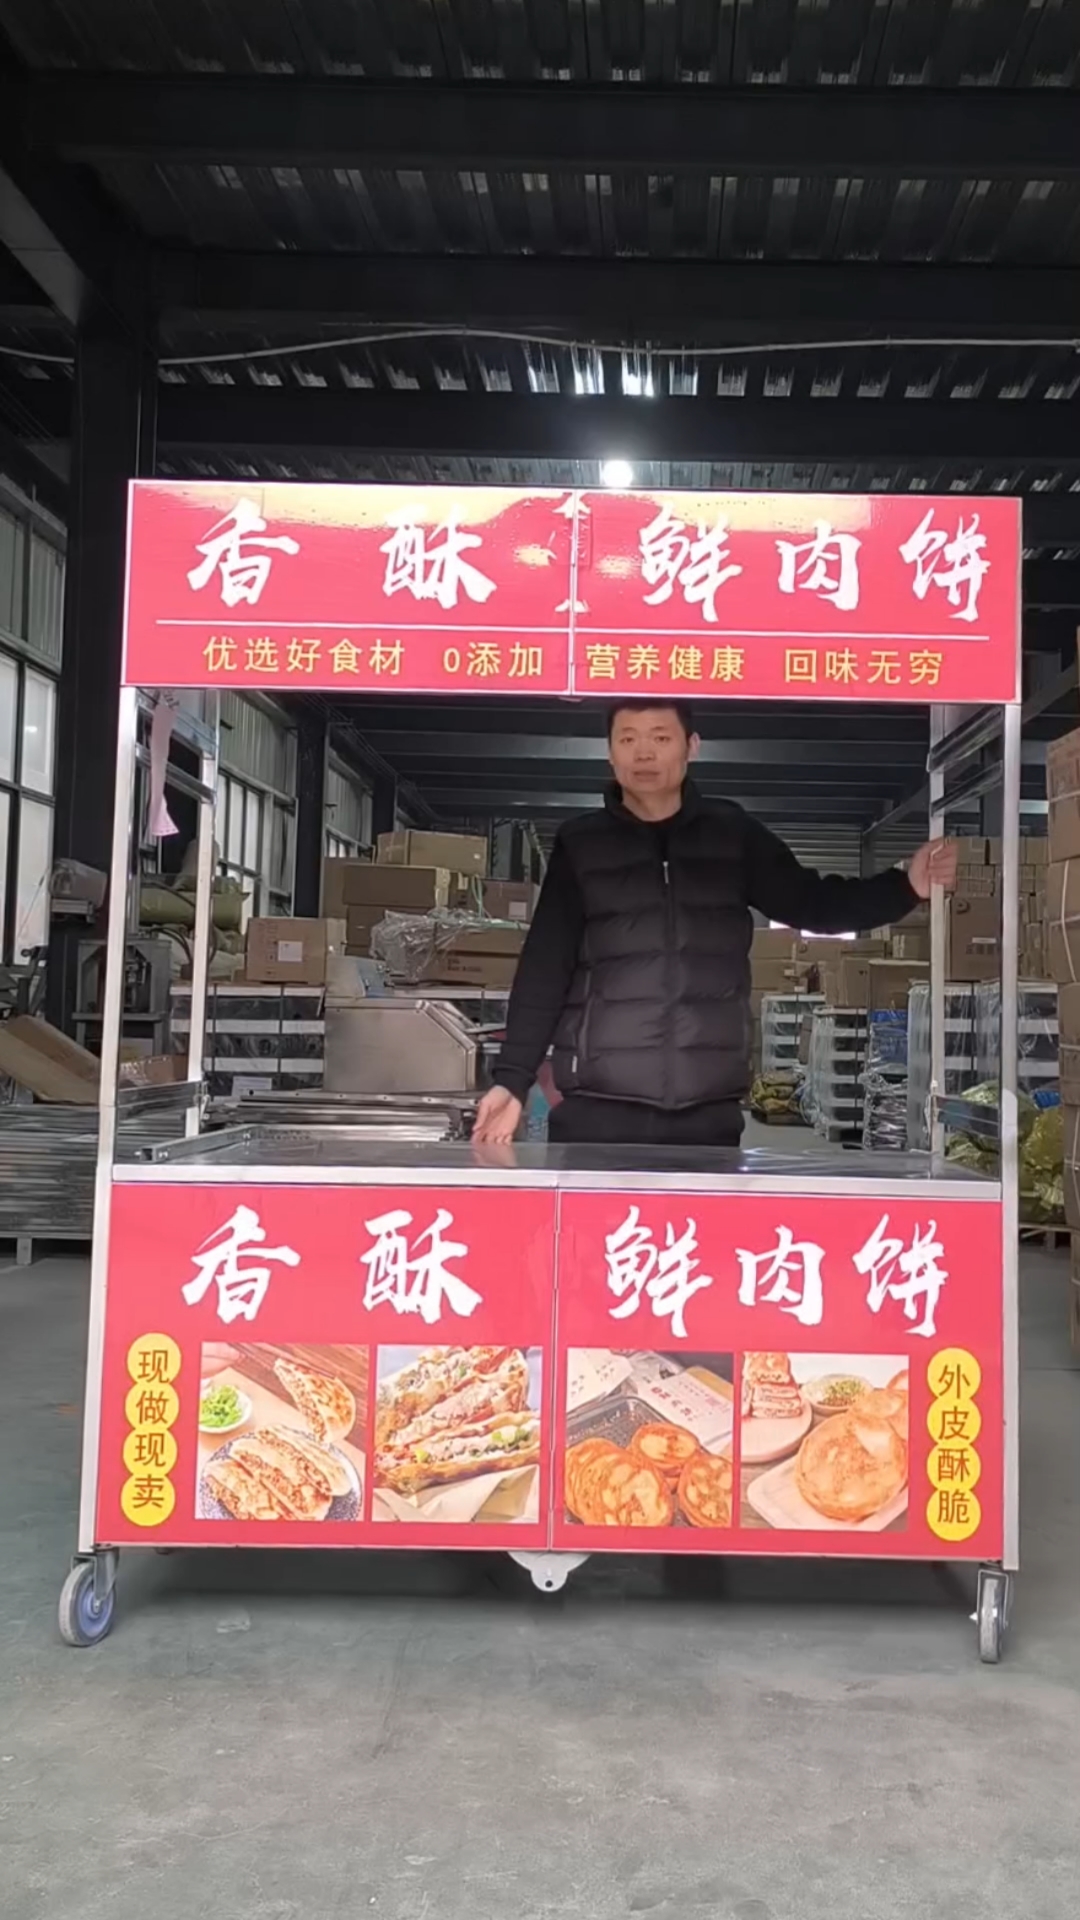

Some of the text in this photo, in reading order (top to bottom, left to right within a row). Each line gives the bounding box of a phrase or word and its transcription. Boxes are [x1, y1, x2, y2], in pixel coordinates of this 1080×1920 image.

[187, 497, 498, 609] 香酥
[638, 503, 991, 622] 鲜肉饼
[202, 635, 943, 687] 优选好食材 0添加 营养健康 回味无穷
[181, 1204, 949, 1338] 香酥 鲜肉饼
[131, 1348, 170, 1510] 现做现卖
[936, 1363, 972, 1525] 外皮酥脆
